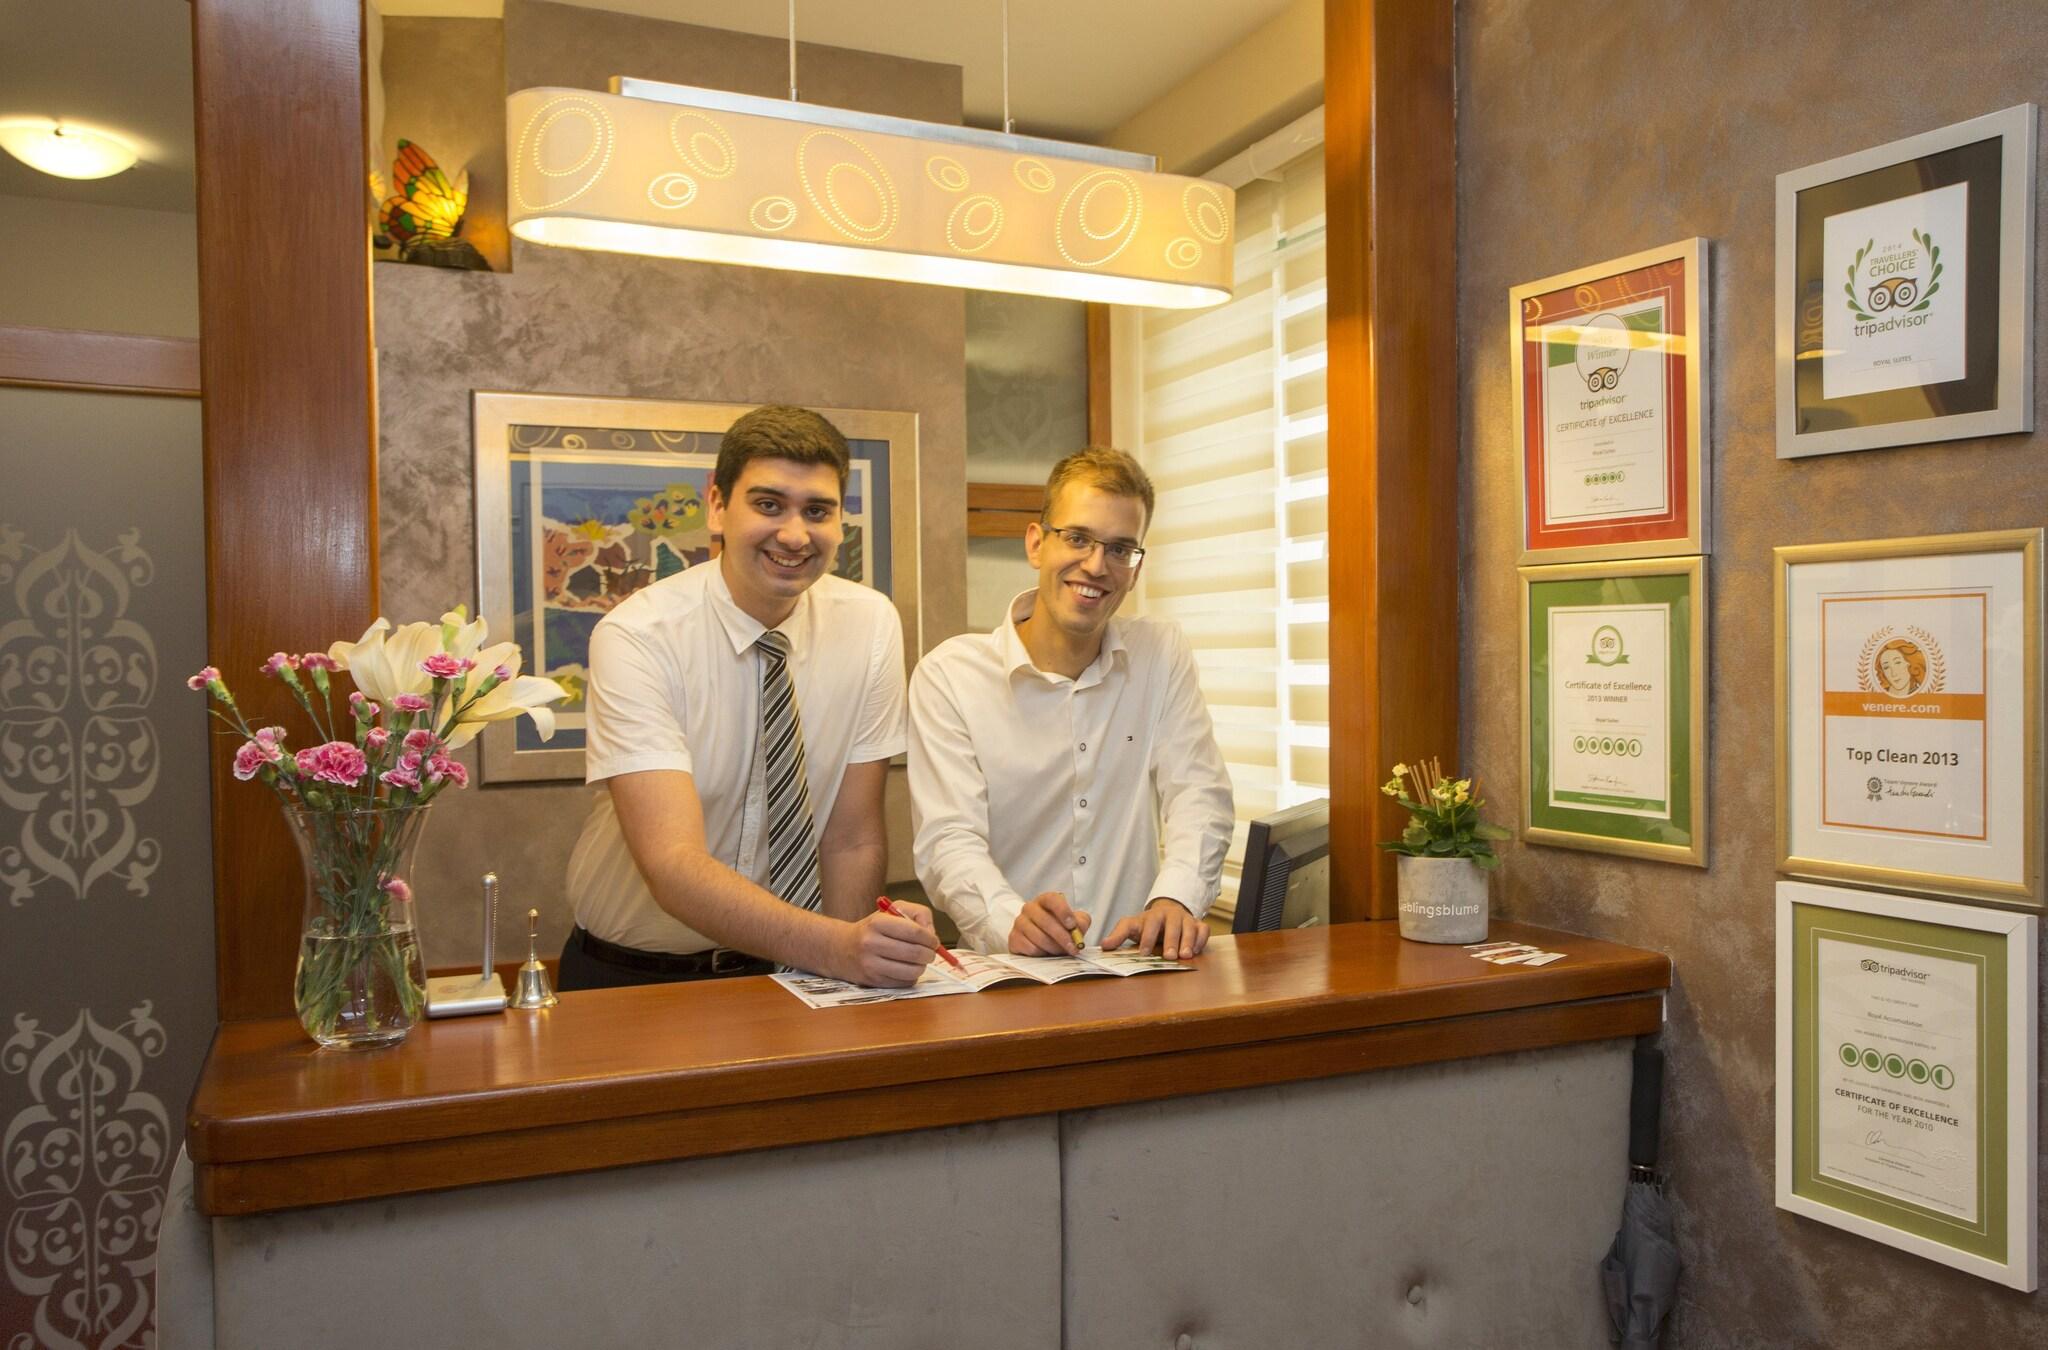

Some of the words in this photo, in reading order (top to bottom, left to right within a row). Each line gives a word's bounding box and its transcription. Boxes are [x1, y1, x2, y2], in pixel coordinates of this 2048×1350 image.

[1869, 258, 1916, 278] CHOICE
[1854, 313, 1929, 338] tripadvisor
[1580, 394, 1626, 410] tripadvisor
[1556, 418, 1597, 433] CERTIFICATE
[1598, 417, 1607, 428] of
[1608, 408, 1655, 425] EXCELLENCE
[1565, 681, 1602, 690] Certificate
[1603, 682, 1612, 690] of
[1613, 682, 1653, 691] Excellence
[1603, 695, 1628, 703] WINNER
[1862, 703, 1941, 714] venere.com
[1846, 747, 1873, 765] Top
[1876, 748, 1918, 764] Clean
[1922, 751, 1959, 766] 2013
[1880, 964, 1927, 980] tripadvisor
[1834, 1088, 1887, 1107] CERTIFICATE
[1888, 1101, 1901, 1111] OF
[1902, 1105, 1959, 1127] EXCELLENCE
[1857, 1104, 1873, 1116] FOR
[1874, 1109, 1889, 1120] THE
[1890, 1113, 1913, 1127] YEAR
[1914, 1119, 1935, 1132] 2010
